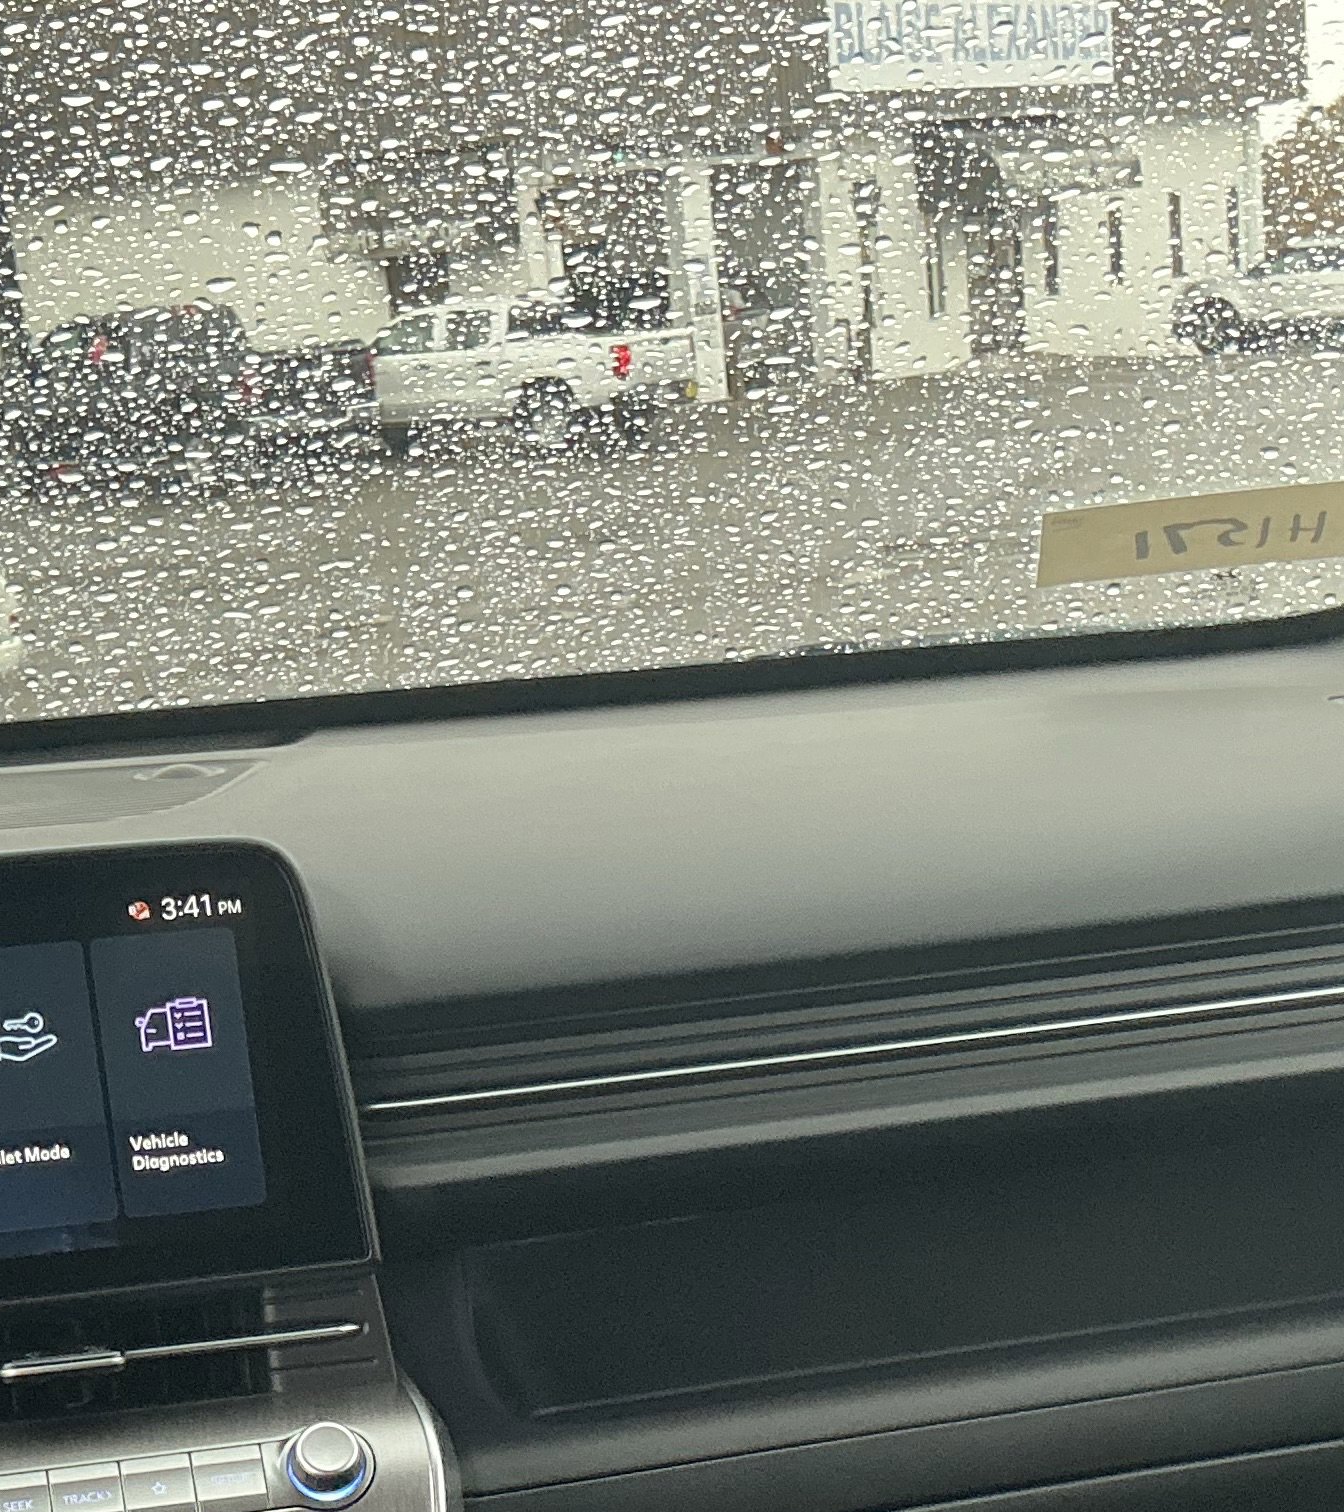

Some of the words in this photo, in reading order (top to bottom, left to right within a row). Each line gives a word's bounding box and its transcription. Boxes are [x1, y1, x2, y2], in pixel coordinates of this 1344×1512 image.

[953, 0, 1112, 61] ALEXANDER
[161, 894, 212, 920] 3:41
[217, 899, 242, 916] PM
[129, 1131, 189, 1152] Vehicle
[24, 1144, 70, 1163] Mode
[132, 1149, 225, 1172] Diagnostics
